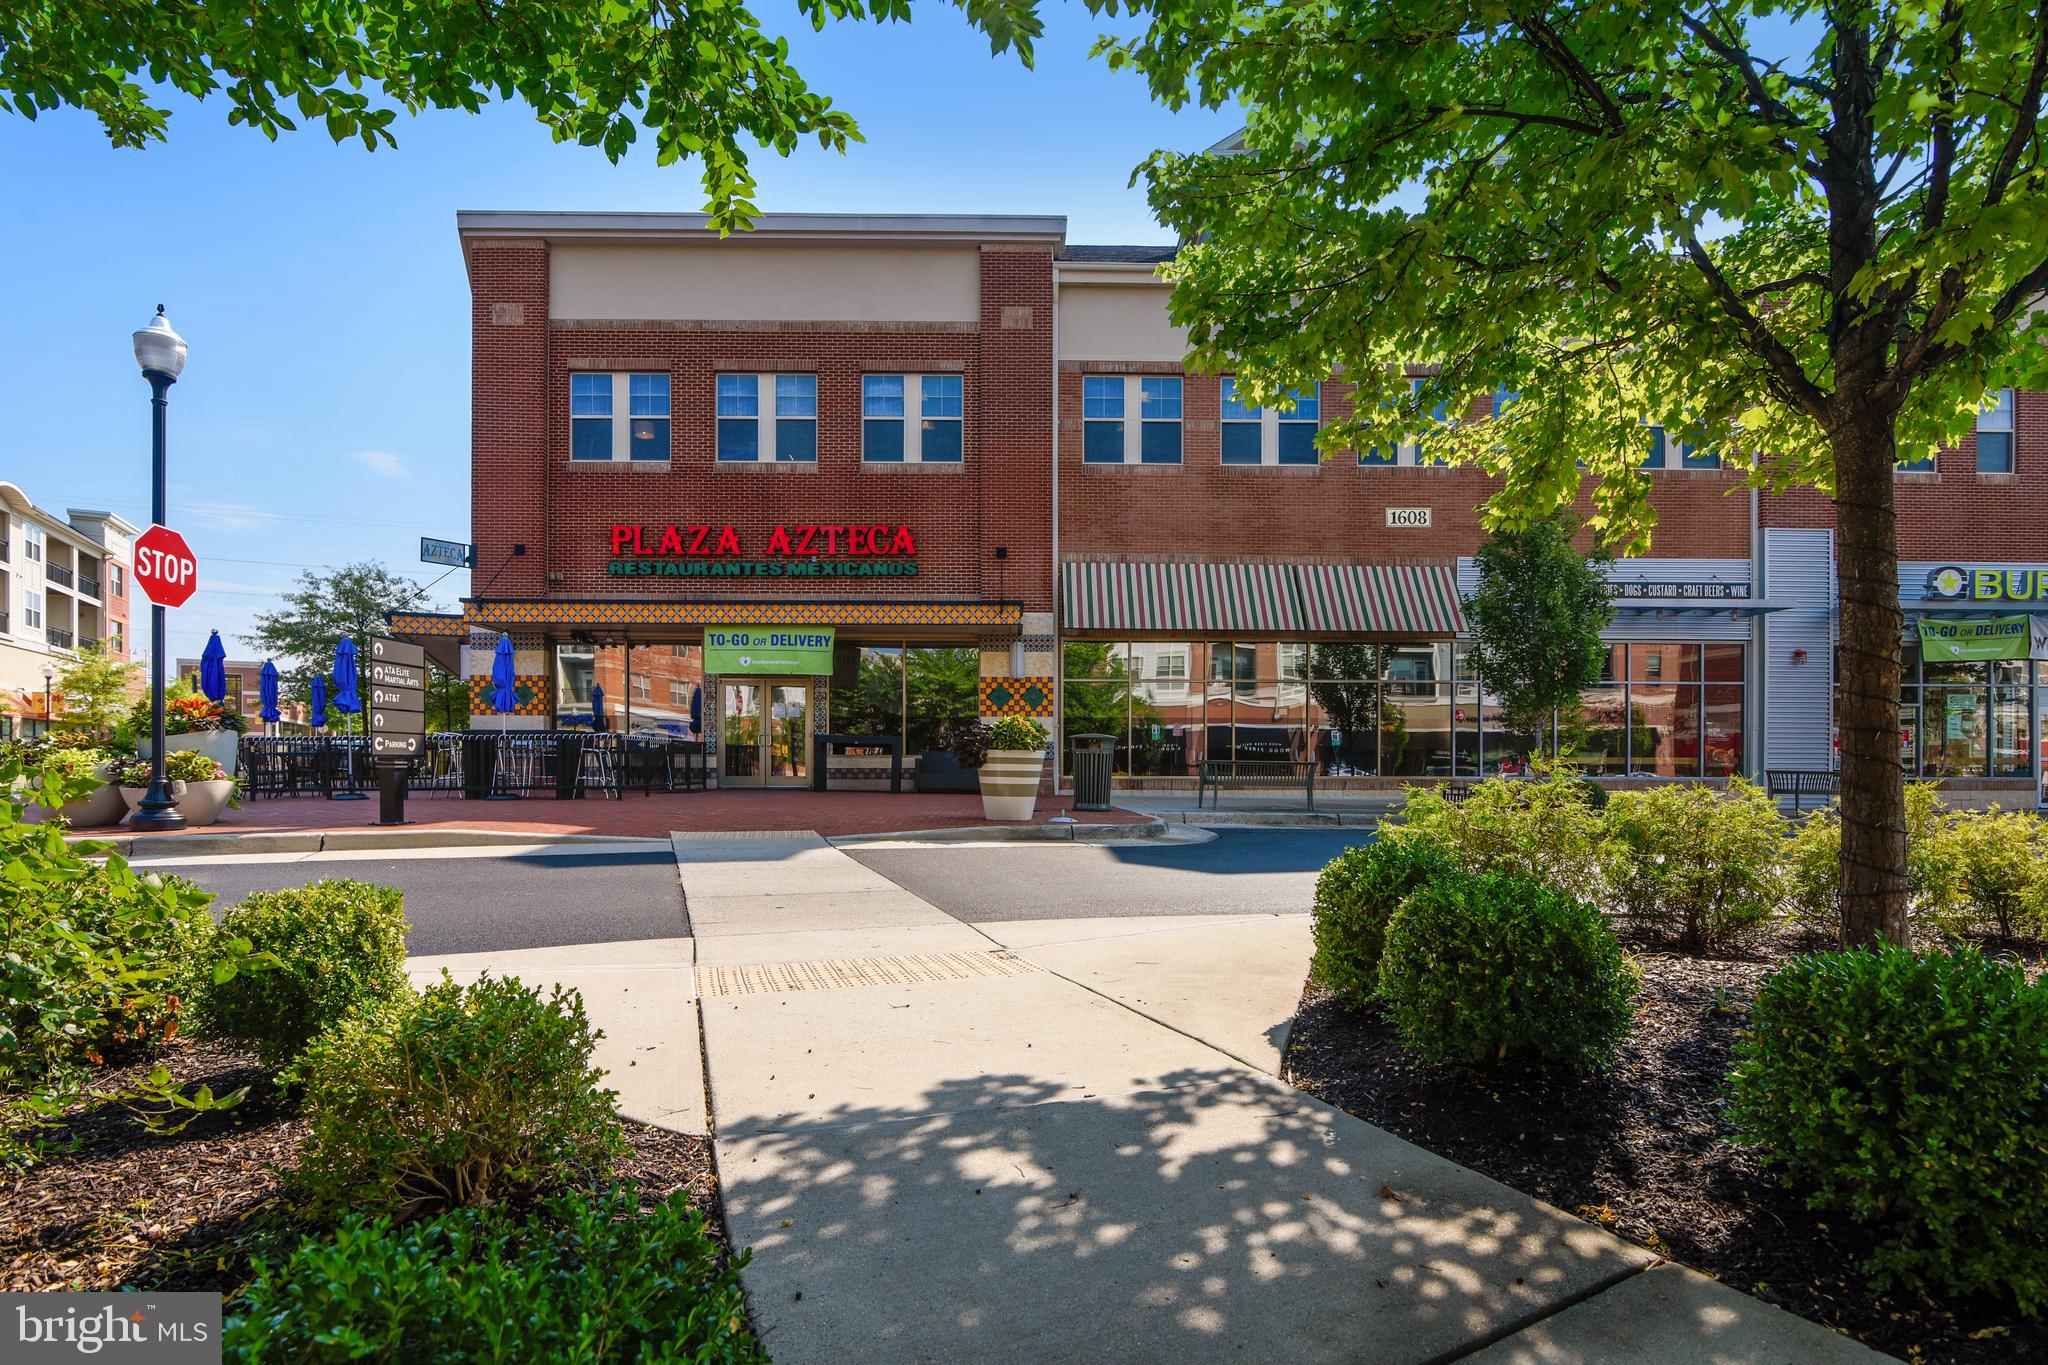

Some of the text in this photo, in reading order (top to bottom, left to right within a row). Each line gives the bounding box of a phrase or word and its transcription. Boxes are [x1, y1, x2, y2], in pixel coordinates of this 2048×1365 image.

[1390, 511, 1427, 525] 1608
[609, 525, 918, 555] PLAZA AZTECA
[424, 543, 464, 562] AZTECA
[137, 546, 194, 586] STOP
[608, 561, 919, 576] RESTAURANTES MEXICANOS
[1624, 584, 1642, 597] DOGS
[1648, 584, 1677, 597] CUSTARD
[1683, 584, 1703, 597] CRAFT
[1704, 585, 1724, 597] BEERS
[1730, 585, 1748, 597] WINE
[1921, 622, 2025, 637] TO-GO OR DELIVERY
[708, 633, 832, 647] TO-GO OR DELIVERY
[384, 666, 396, 676] ATA
[384, 693, 400, 703] AT&T
